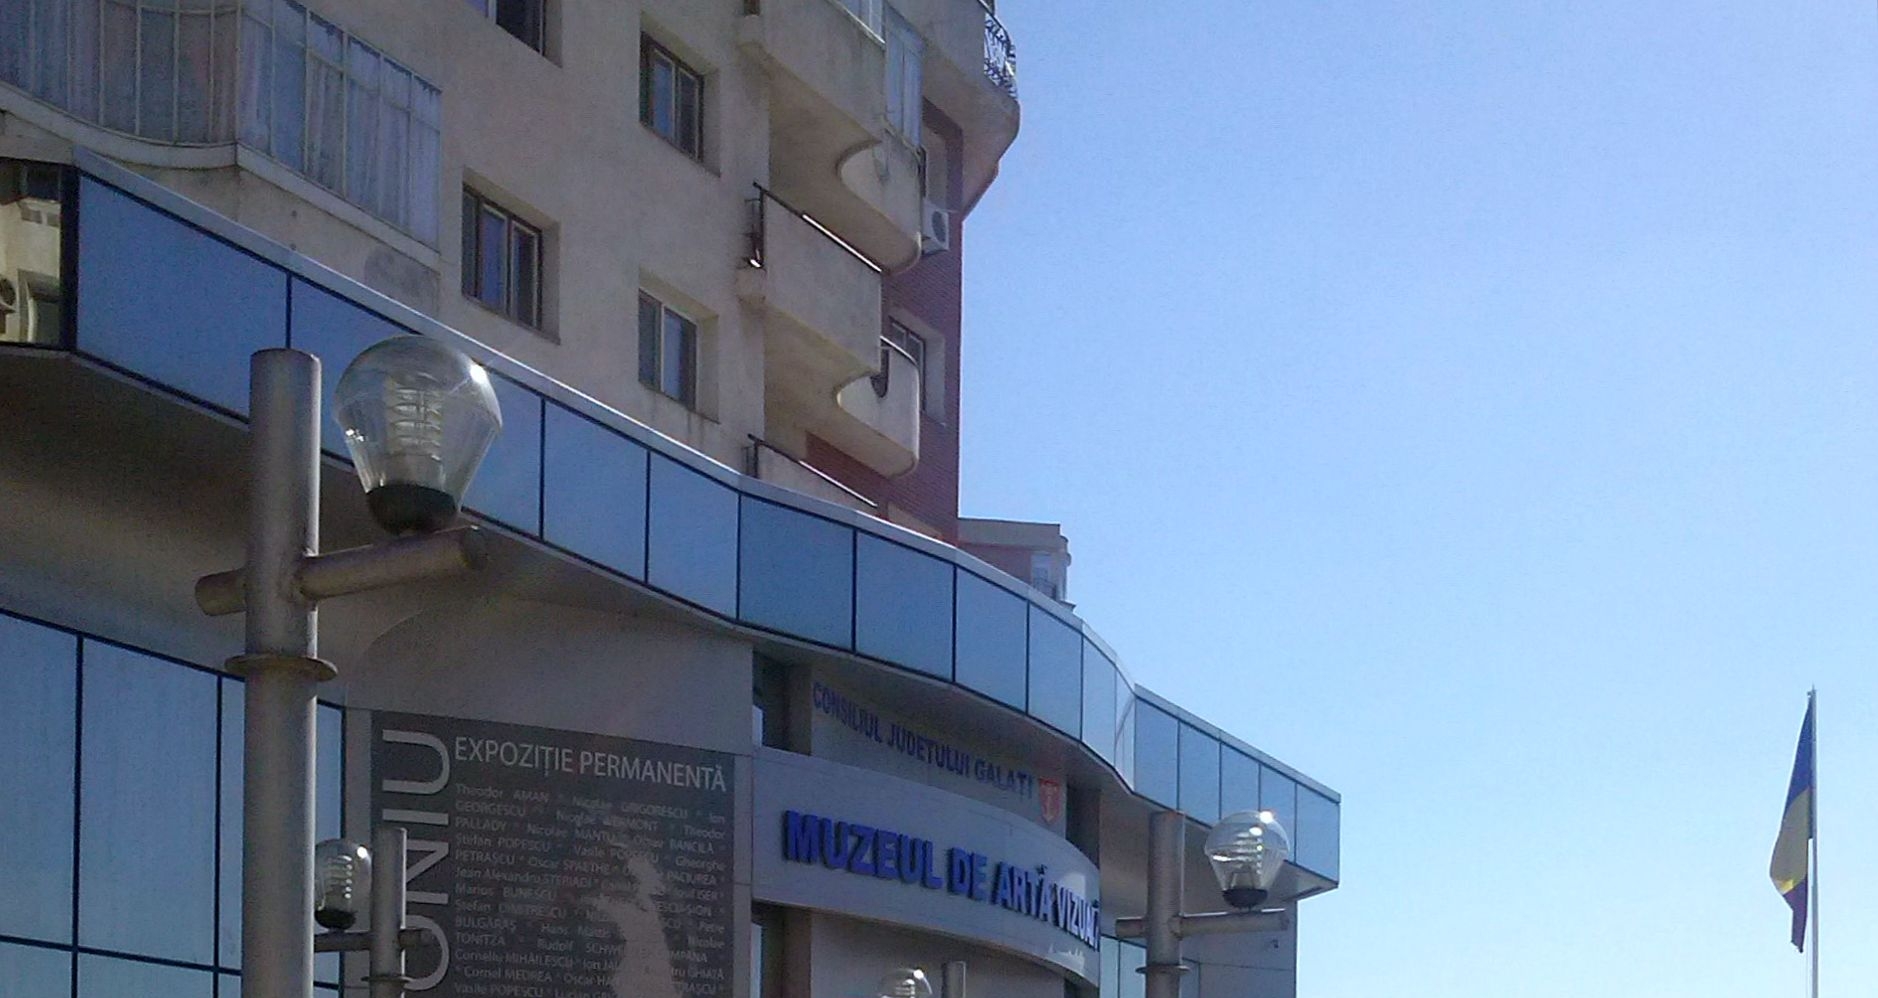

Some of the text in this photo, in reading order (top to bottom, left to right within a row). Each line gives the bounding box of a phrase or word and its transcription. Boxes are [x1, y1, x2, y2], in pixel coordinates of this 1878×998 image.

[813, 681, 882, 744] CONSILIUL
[579, 751, 727, 792] PERMANENTĂ
[455, 799, 526, 816] GEORGESCU
[454, 815, 507, 831] PALLADY
[497, 836, 550, 852] POPESCU
[783, 810, 944, 890] MUZEUL
[947, 846, 989, 902] DE
[992, 861, 1054, 923] ARTĂ
[454, 932, 505, 946] TONITZA
[463, 966, 501, 979] Cornel
[489, 984, 543, 998] POPESCU
